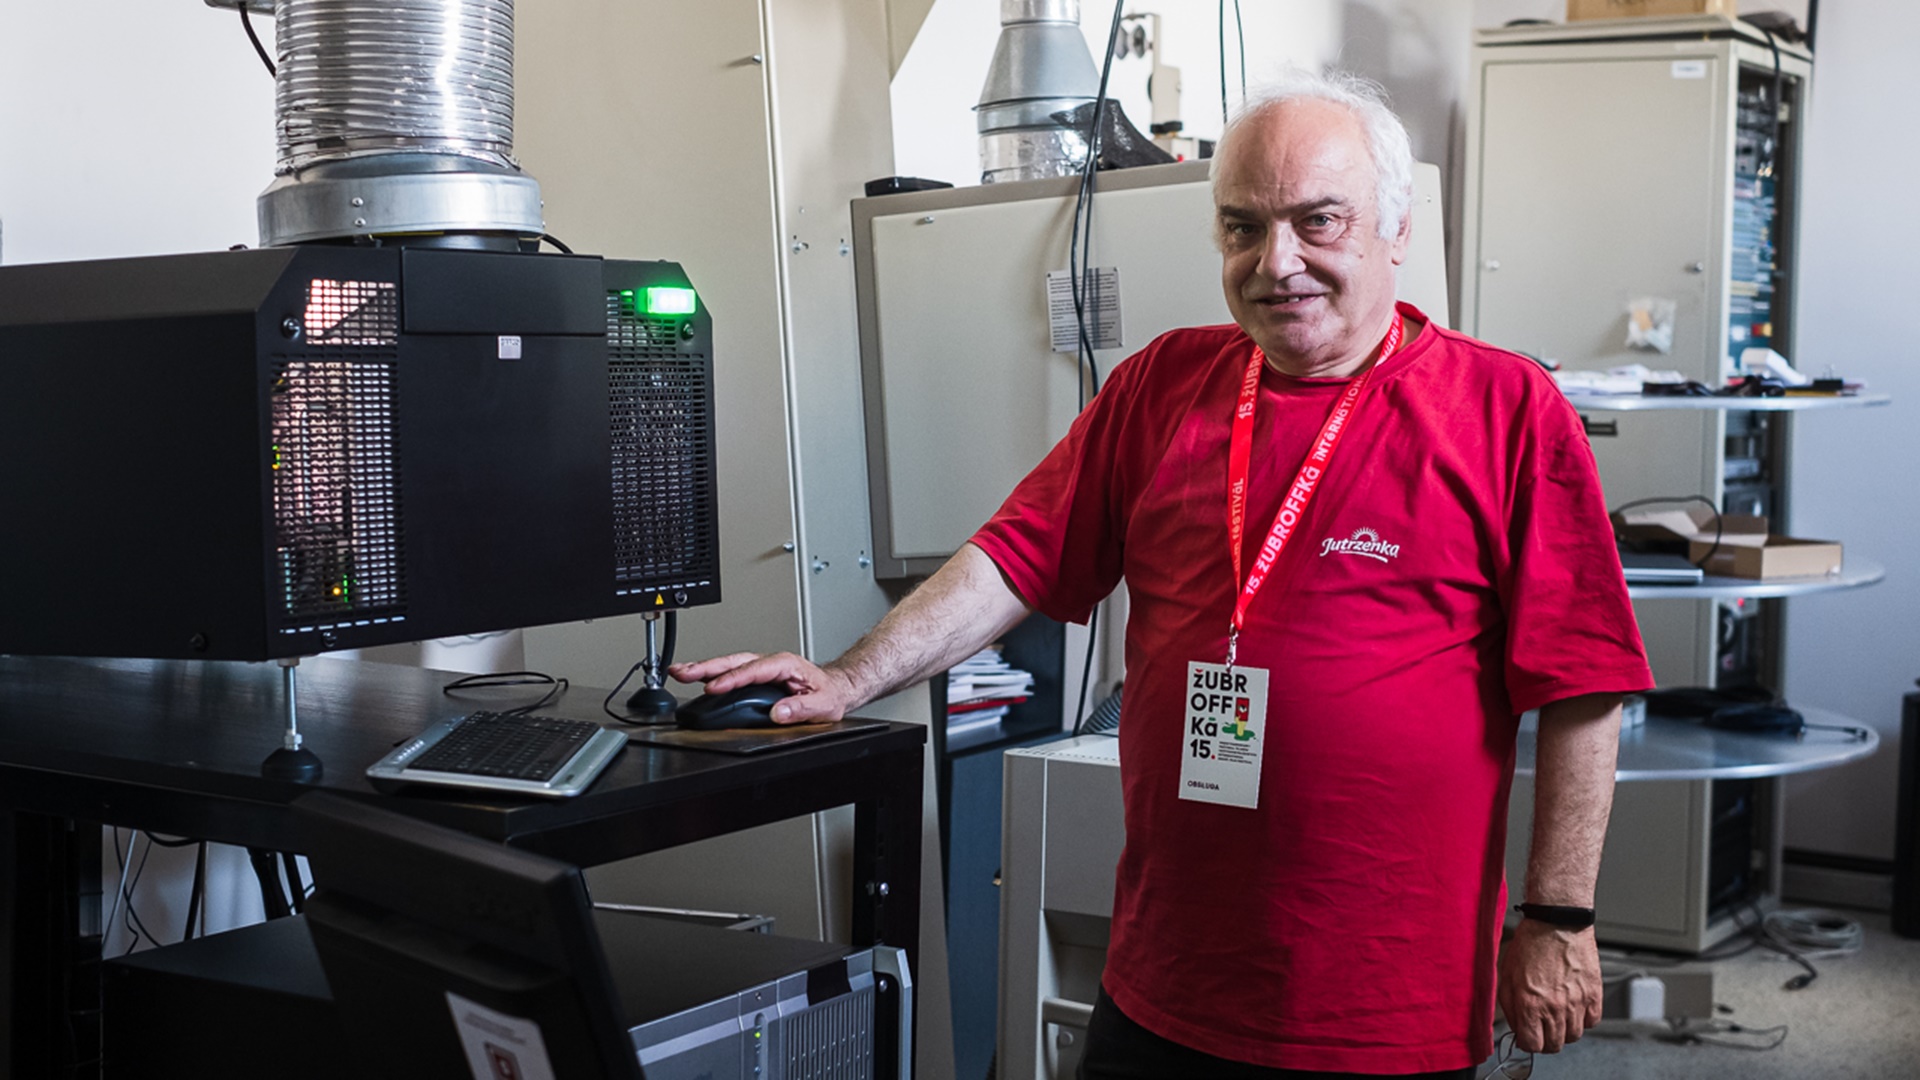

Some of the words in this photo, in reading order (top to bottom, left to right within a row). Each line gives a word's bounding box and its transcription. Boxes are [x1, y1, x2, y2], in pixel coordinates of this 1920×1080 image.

[1238, 398, 1254, 419] 15.
[1319, 537, 1400, 558] Jutrzenka
[1245, 575, 1264, 595] 15.
[1190, 692, 1233, 714] OFF
[1190, 738, 1216, 759] 15.
